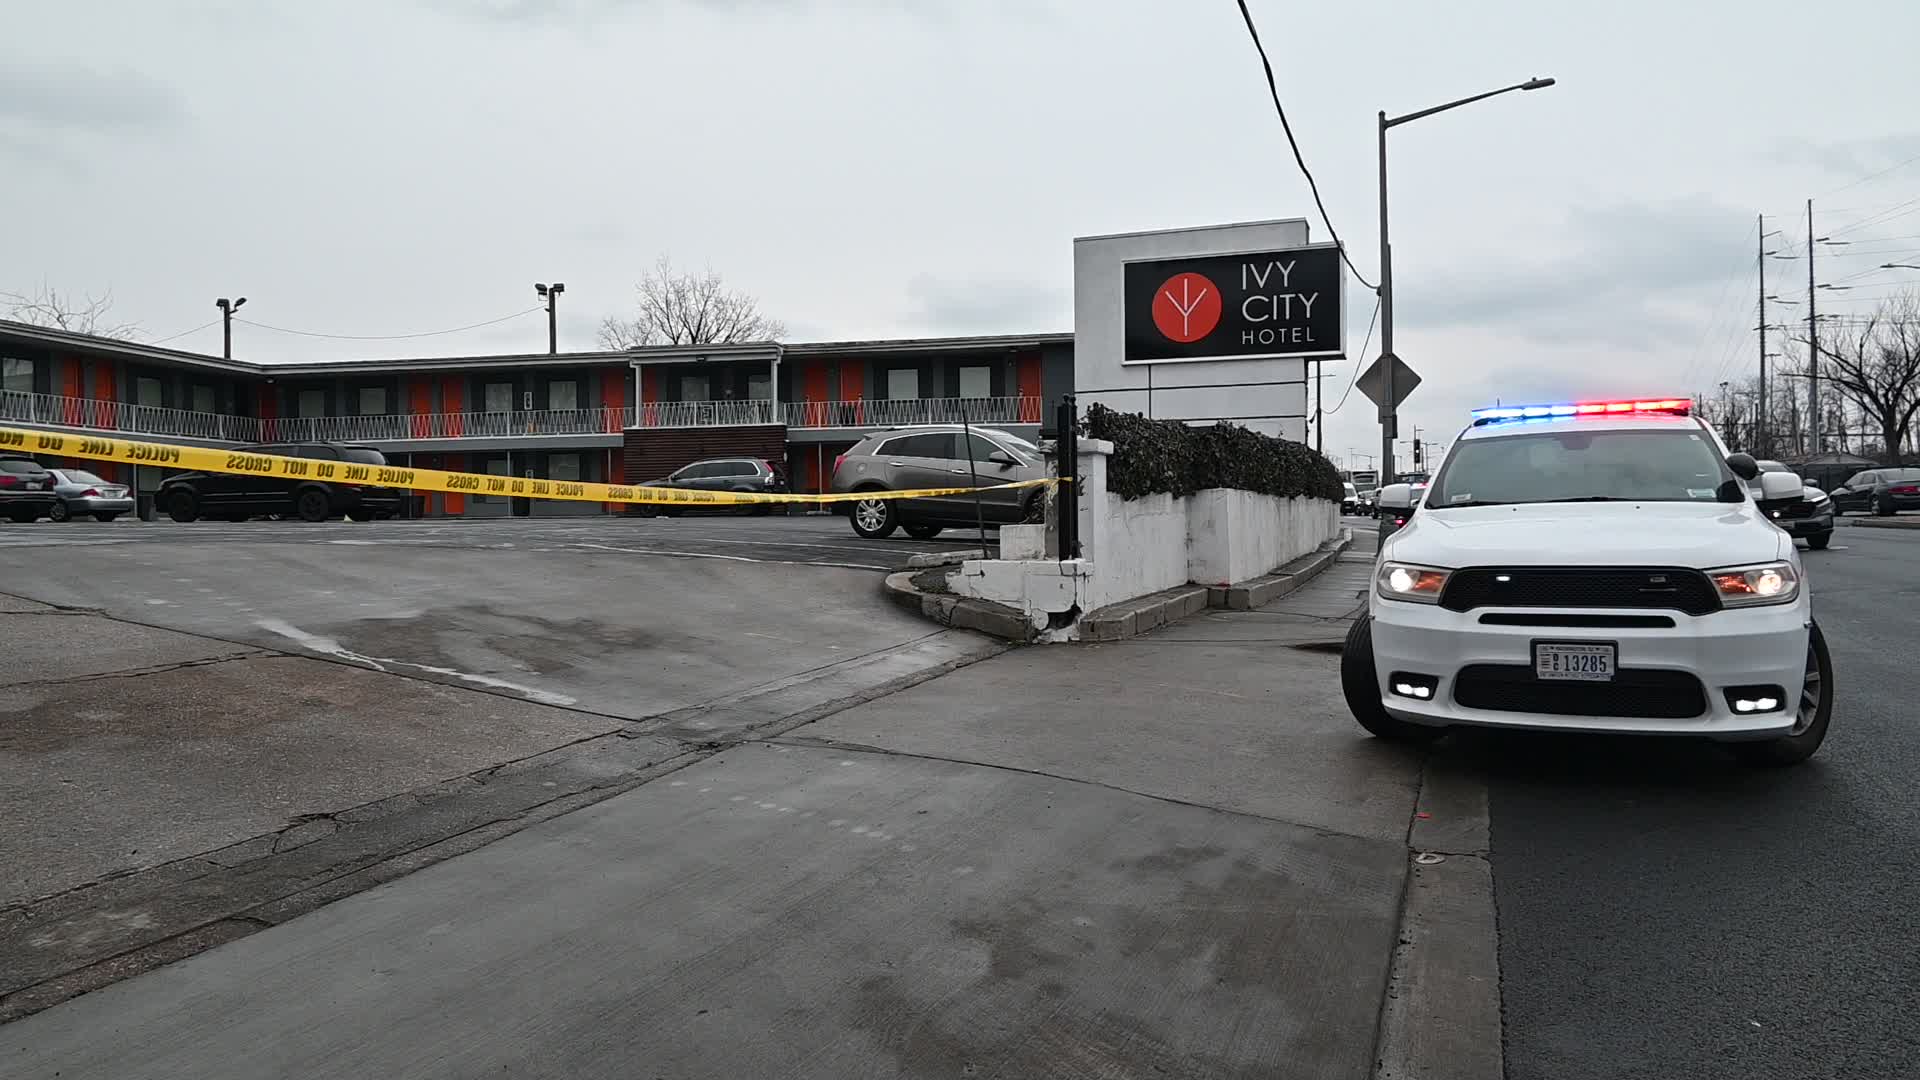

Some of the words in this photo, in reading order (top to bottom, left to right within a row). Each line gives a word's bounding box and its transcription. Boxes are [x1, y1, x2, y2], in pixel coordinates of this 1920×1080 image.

[1241, 259, 1297, 290] IVY
[1241, 291, 1319, 323] CITY
[1241, 326, 1316, 345] HOTEL
[1564, 654, 1607, 673] 13285
